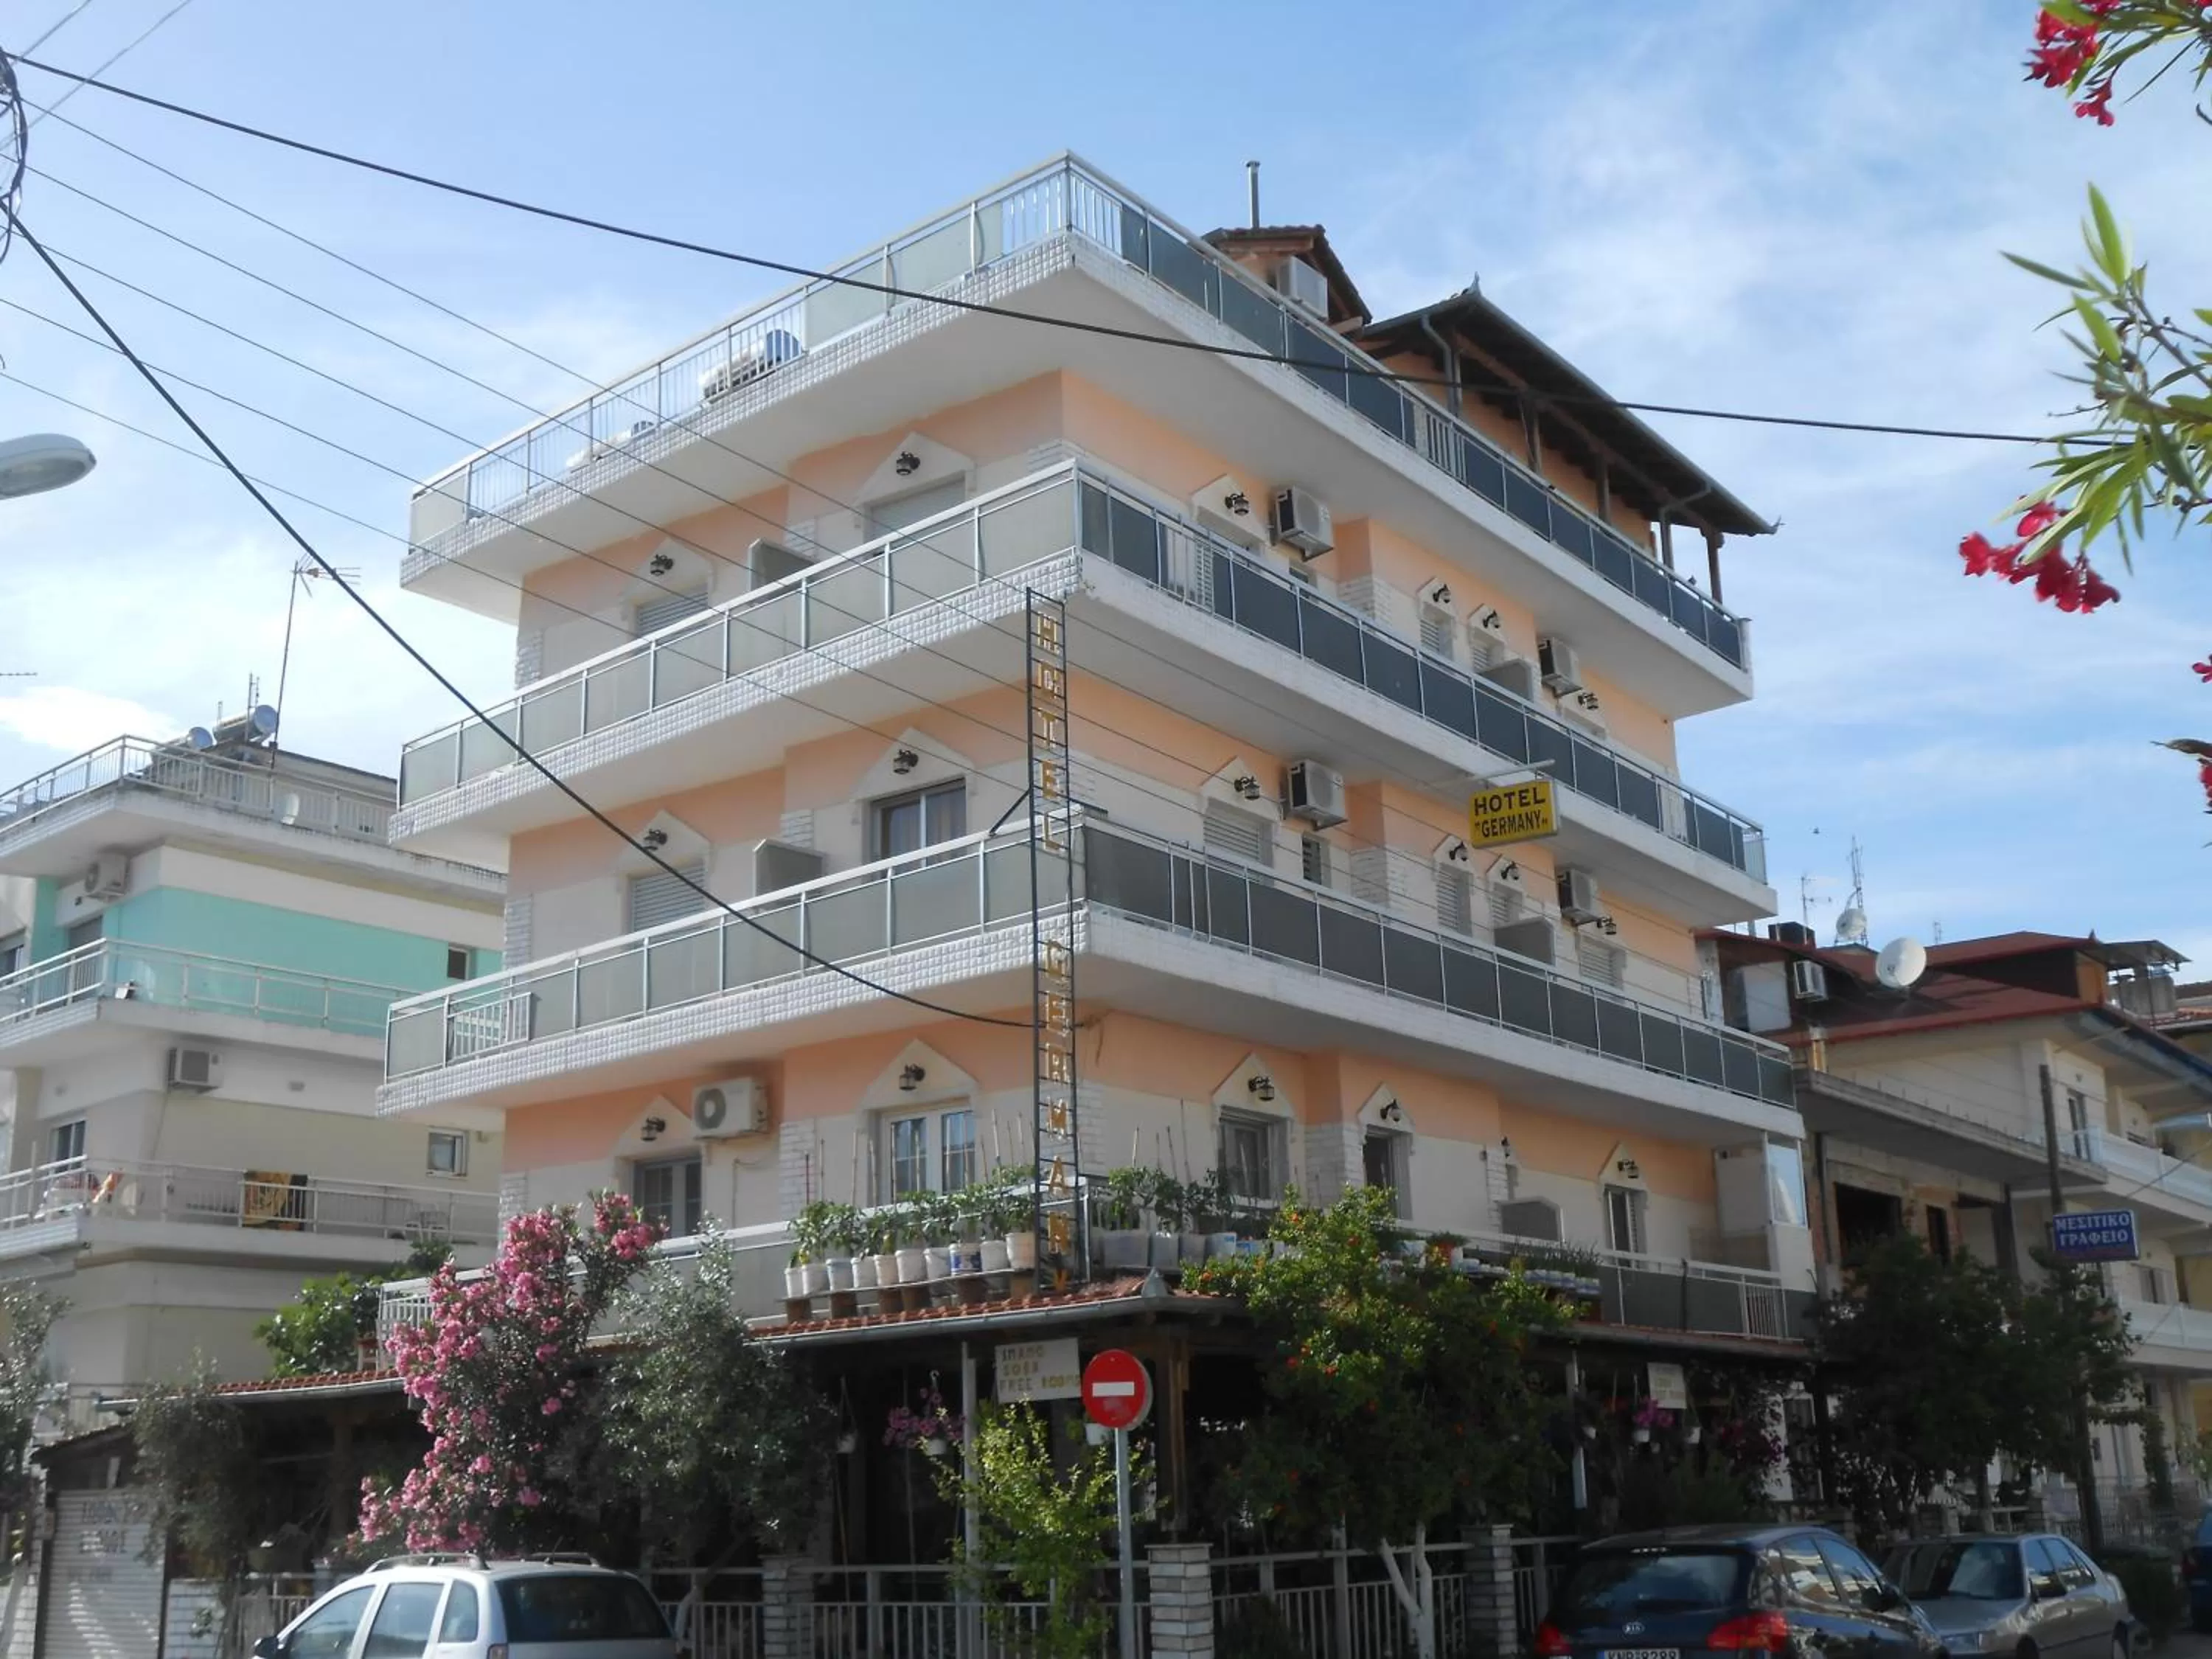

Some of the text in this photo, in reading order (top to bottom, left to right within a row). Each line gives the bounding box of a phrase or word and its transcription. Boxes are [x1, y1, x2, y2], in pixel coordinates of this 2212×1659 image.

[1036, 610, 1062, 853] HOTEL
[1474, 787, 1546, 816] HOTEL
[2055, 1213, 2130, 1231] ΜΕΣΙΤΙΚΟ
[2059, 1229, 2129, 1247] ΓΡΑΦΕΙΟ
